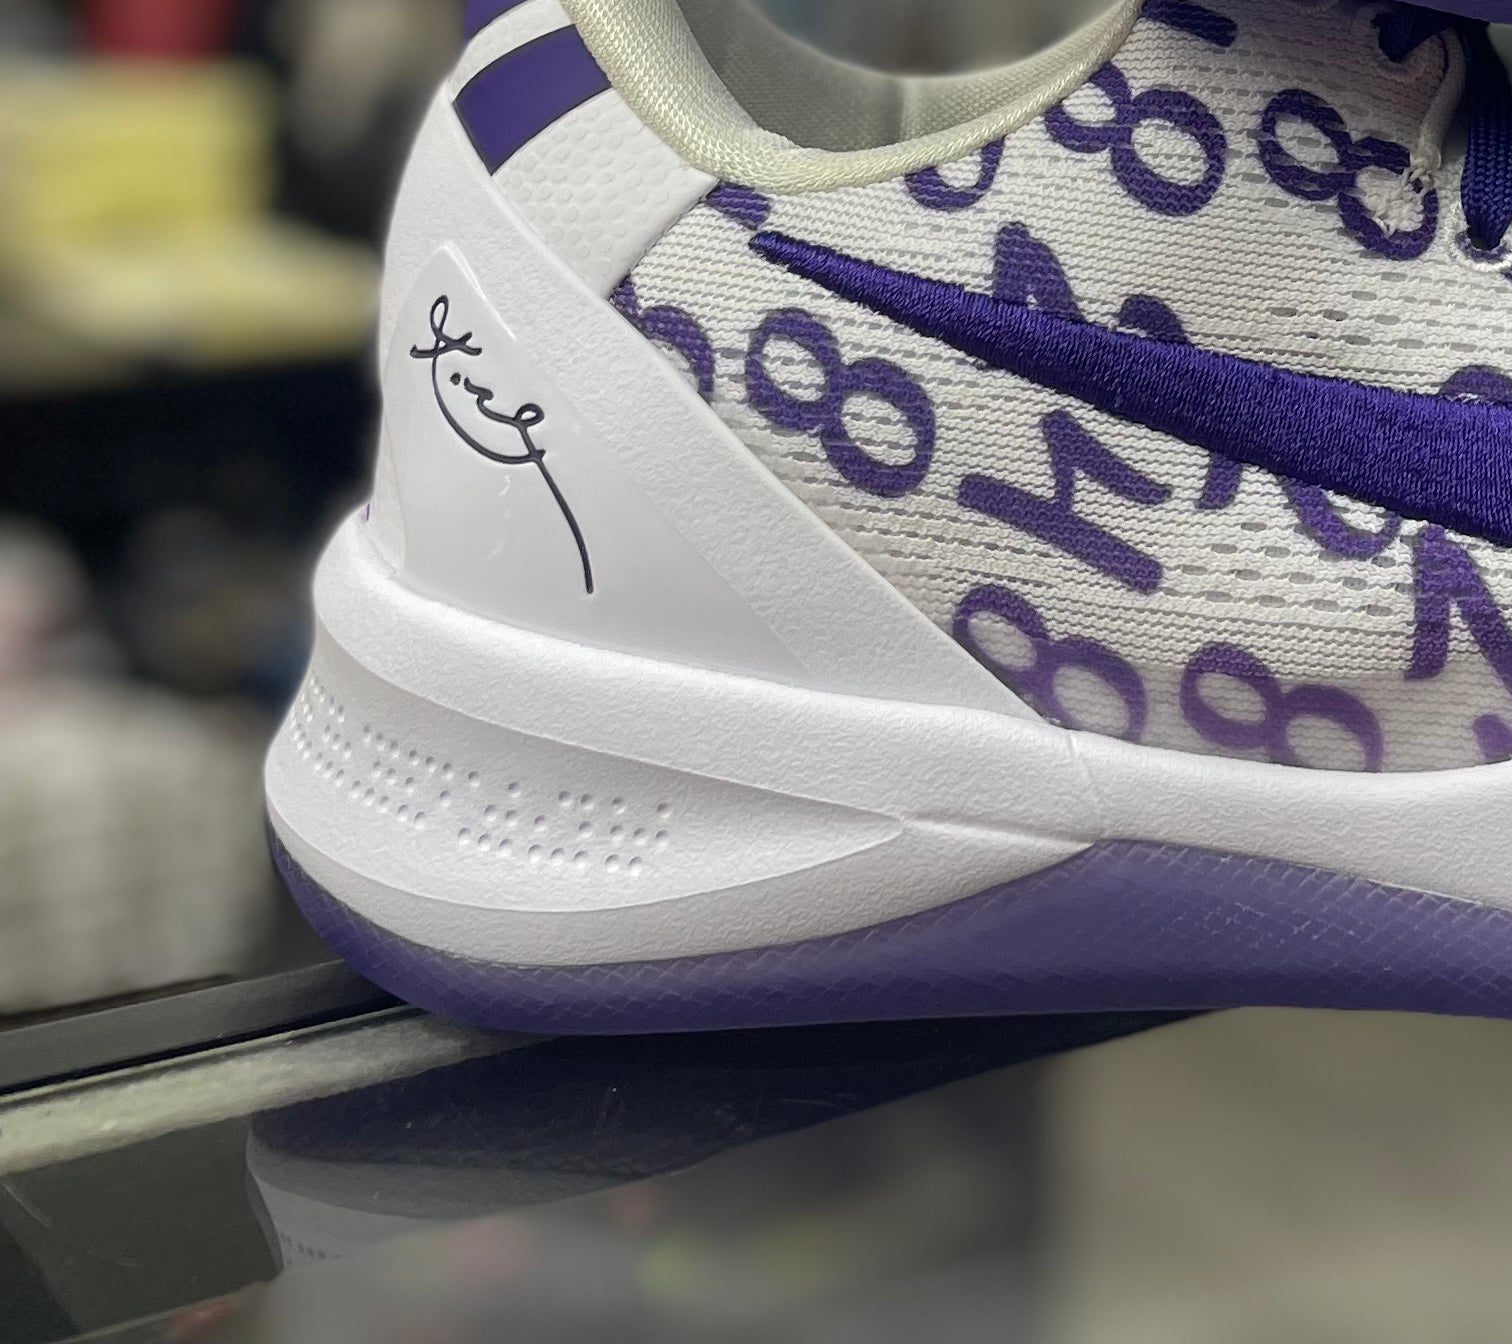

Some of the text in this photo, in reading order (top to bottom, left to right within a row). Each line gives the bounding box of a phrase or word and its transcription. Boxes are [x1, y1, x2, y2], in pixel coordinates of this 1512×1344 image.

[1045, 62, 1228, 216] 8
[1258, 88, 1440, 261] 8
[744, 306, 937, 499] 8
[952, 583, 1150, 742] 8
[1180, 642, 1385, 773] 8
